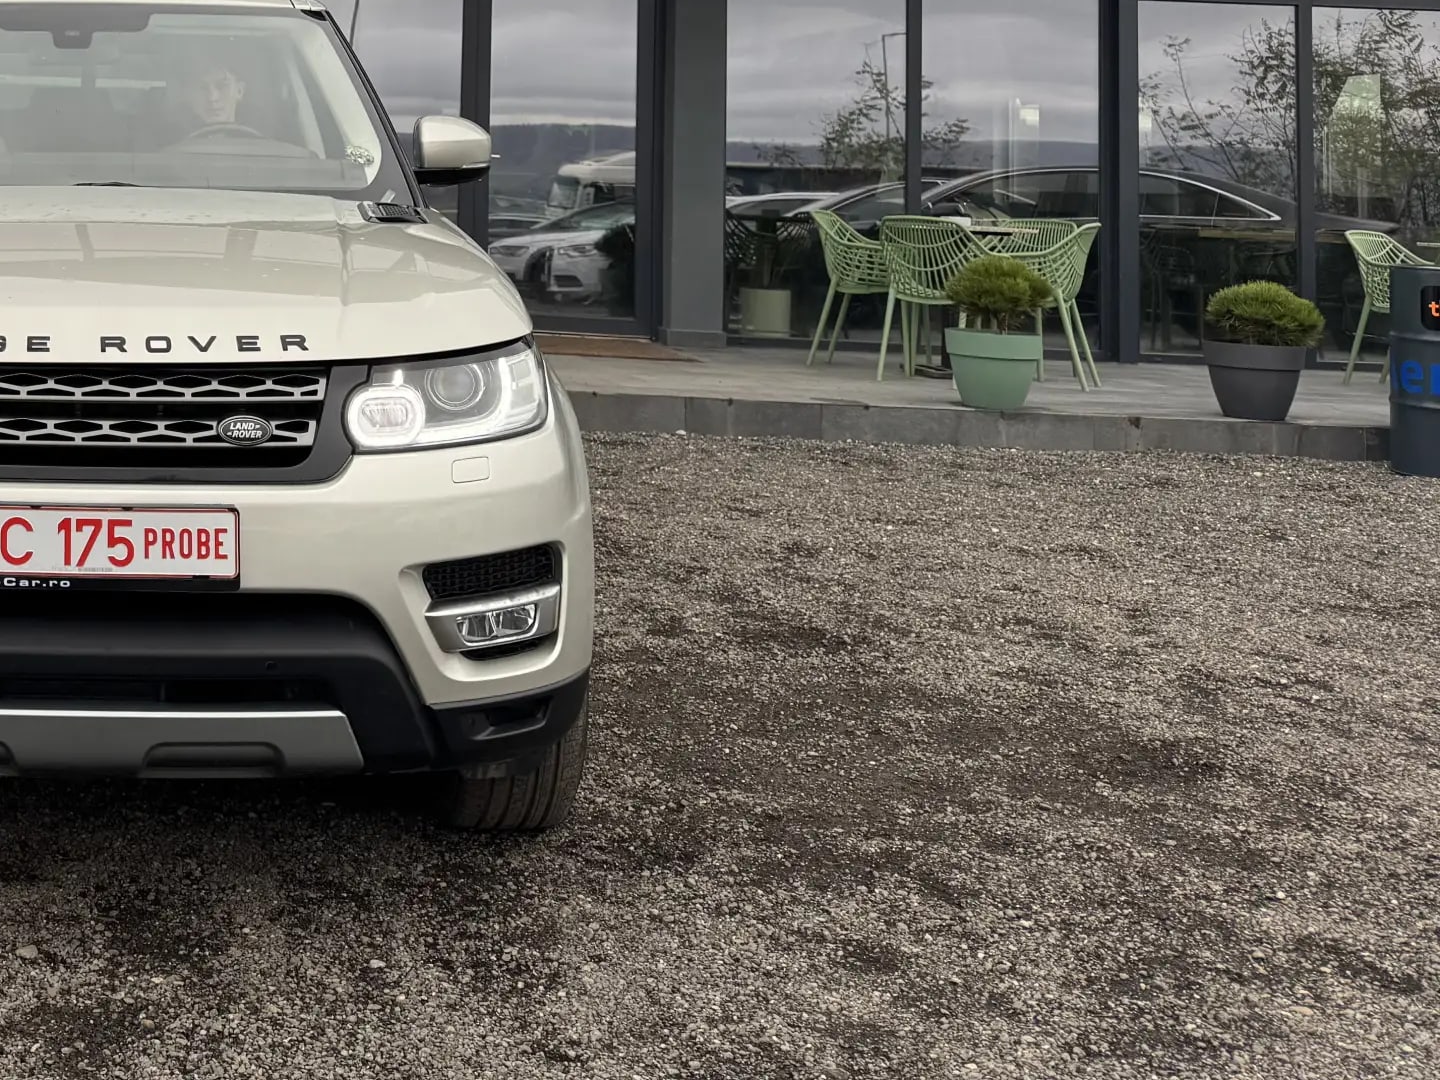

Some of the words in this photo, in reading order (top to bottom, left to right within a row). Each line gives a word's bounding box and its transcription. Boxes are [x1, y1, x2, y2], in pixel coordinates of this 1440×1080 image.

[100, 334, 309, 353] ROVER
[229, 422, 255, 430] LAND
[232, 430, 263, 438] ROVER
[57, 517, 135, 568] 175
[144, 527, 229, 560] PROBE
